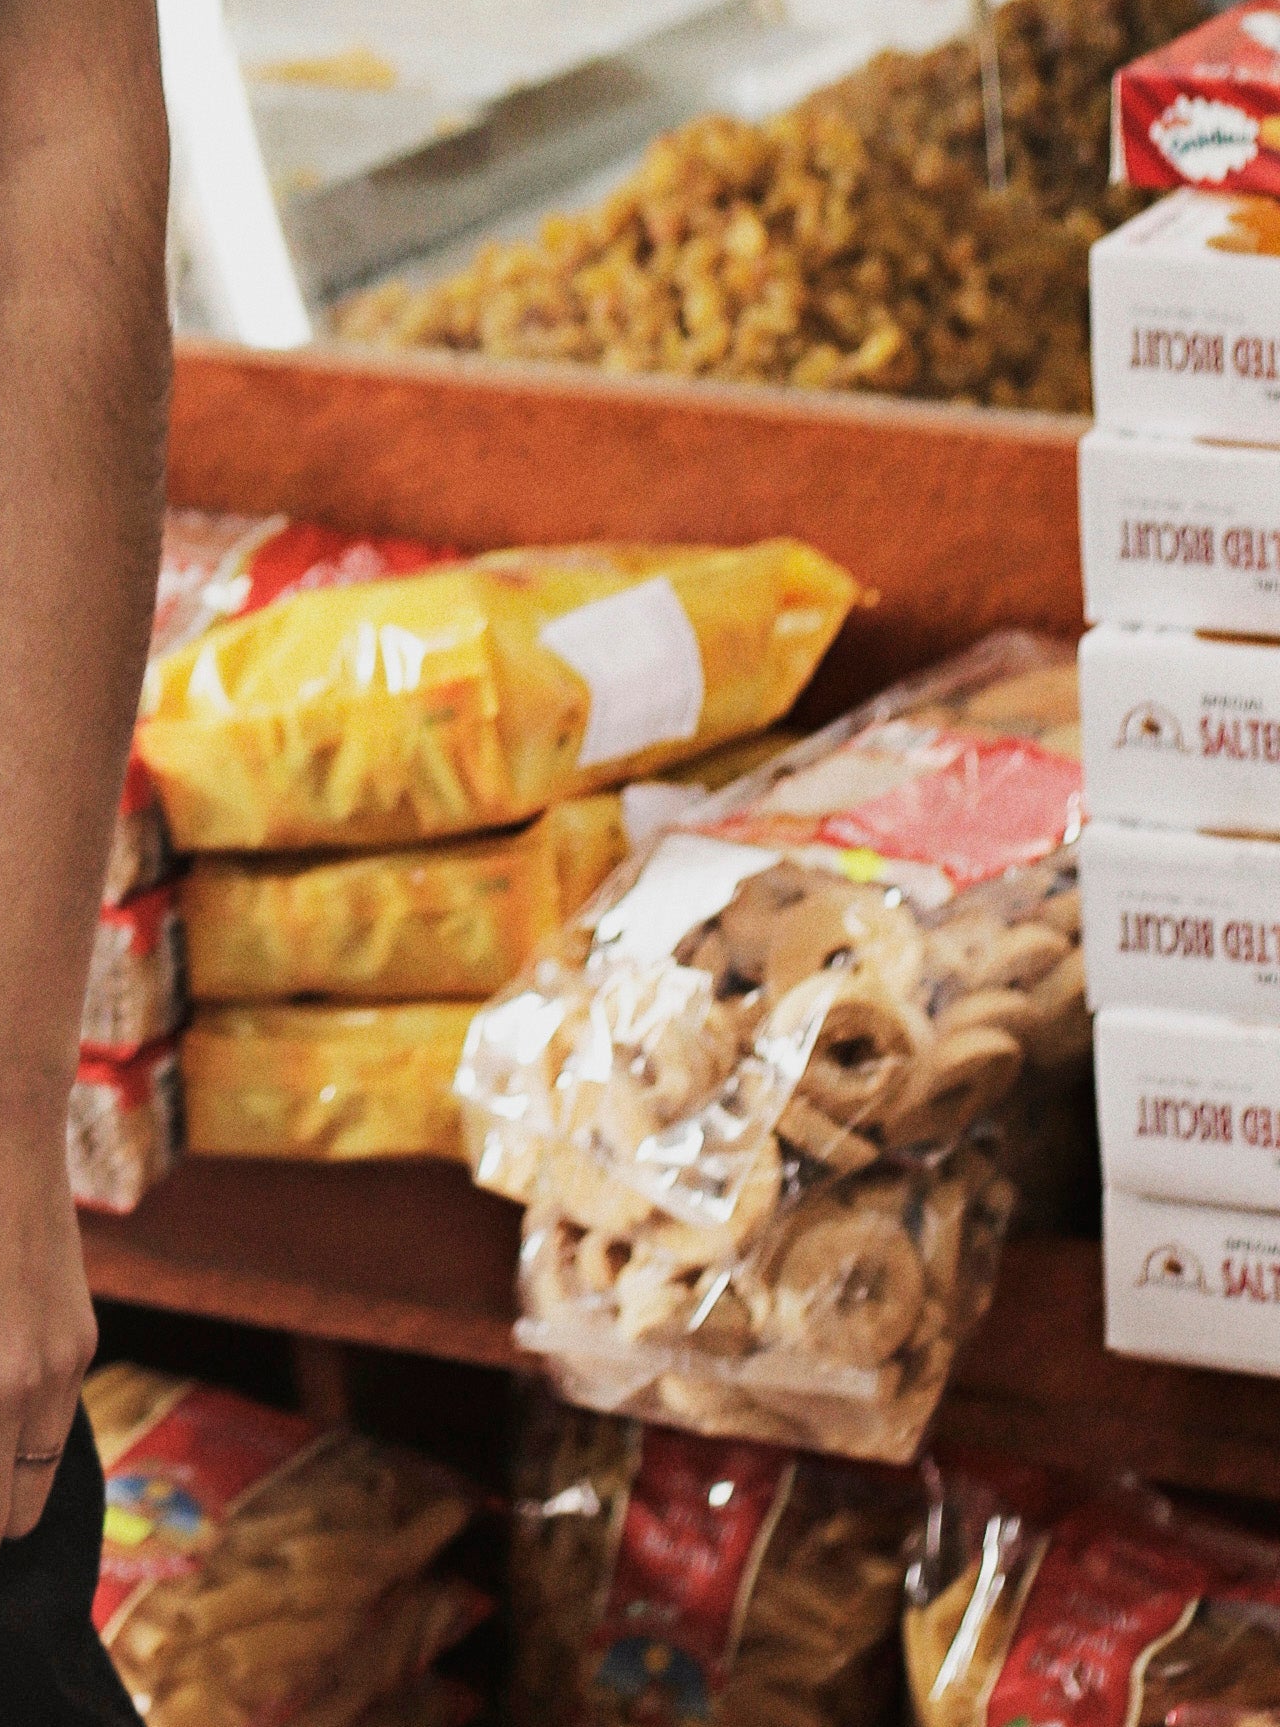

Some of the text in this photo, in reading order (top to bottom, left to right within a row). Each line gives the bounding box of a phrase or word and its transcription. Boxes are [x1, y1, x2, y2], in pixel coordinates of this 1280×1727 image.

[1131, 327, 1225, 377] BISCUIT
[1120, 518, 1215, 568] BISCUIT
[1199, 715, 1280, 764] SALTE
[1119, 912, 1215, 960] BISCUIT
[1138, 1096, 1232, 1145] BISCUIT
